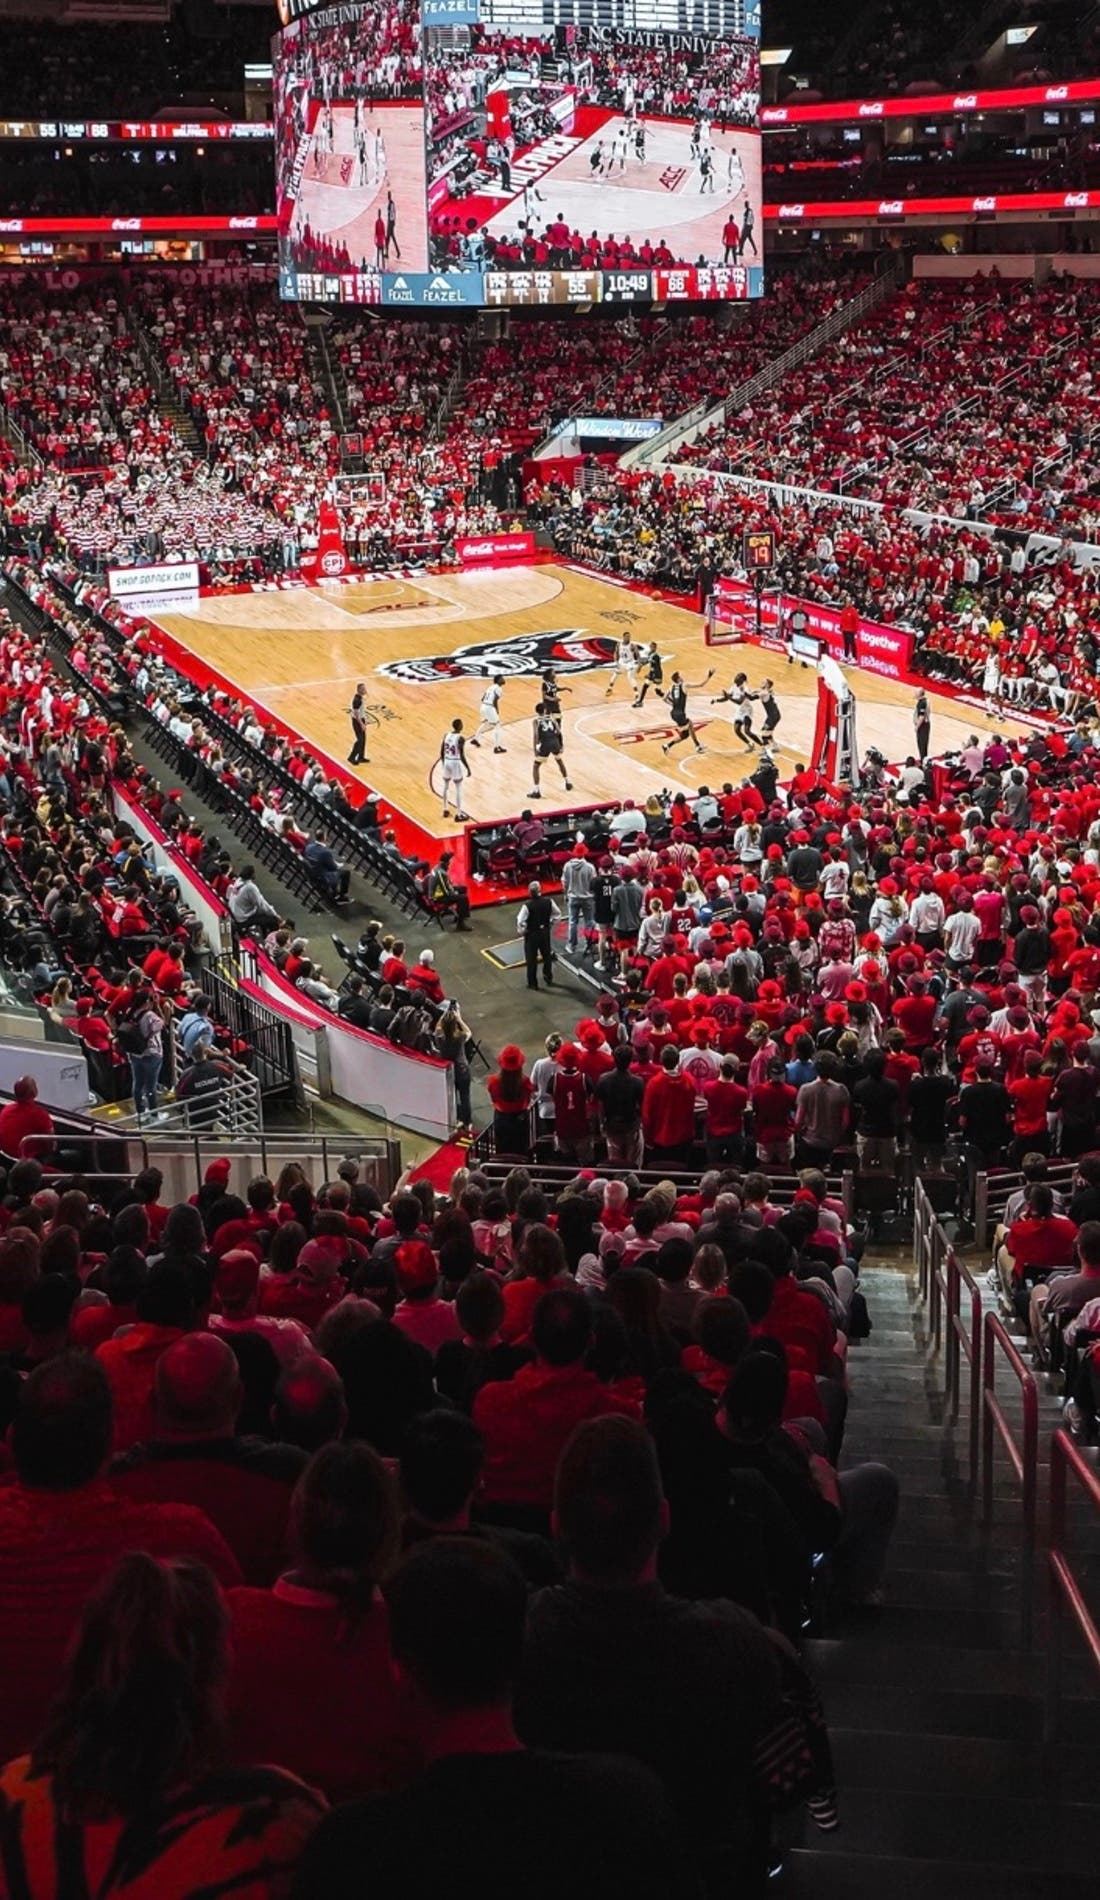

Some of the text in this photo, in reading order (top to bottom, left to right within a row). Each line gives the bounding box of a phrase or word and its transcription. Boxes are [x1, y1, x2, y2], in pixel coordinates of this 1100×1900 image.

[588, 26, 612, 42] NC
[616, 29, 665, 48] STATE
[659, 166, 681, 189] ACC
[568, 280, 587, 294] 55
[608, 275, 648, 291] 10:49
[668, 278, 685, 291] 66
[423, 289, 466, 302] FEAZEL
[755, 546, 769, 564] 19
[324, 558, 343, 567] CPI
[861, 630, 900, 651] together
[602, 885, 612, 896] 21
[677, 918, 691, 932] 22
